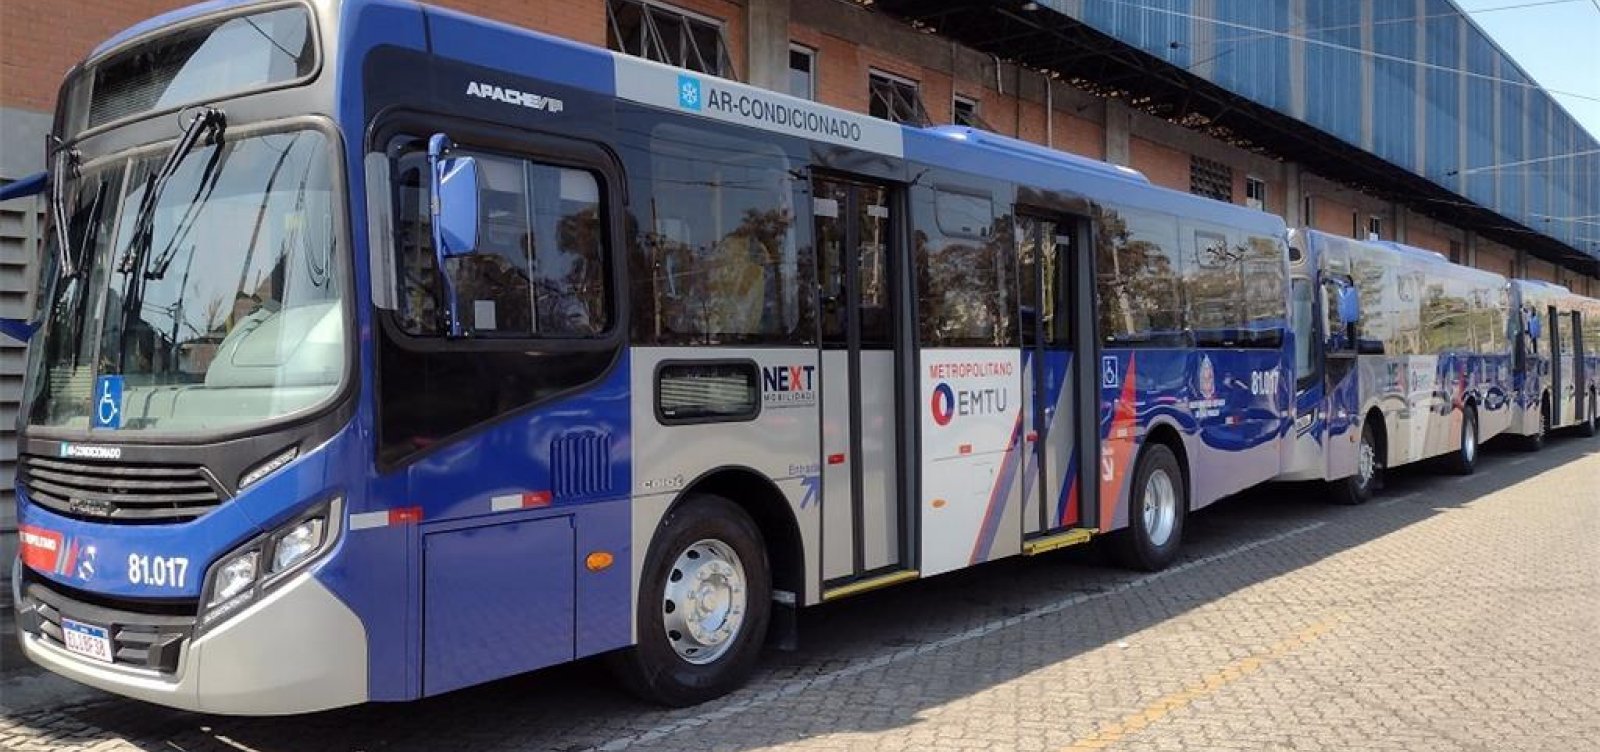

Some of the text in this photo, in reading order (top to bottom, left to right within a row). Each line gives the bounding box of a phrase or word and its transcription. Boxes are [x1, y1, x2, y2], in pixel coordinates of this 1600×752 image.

[707, 88, 862, 142] AR-CONDICIONADO
[763, 365, 815, 392] NEXT
[929, 361, 1013, 379] METROPOLITANO
[958, 387, 1007, 416] EMTU
[128, 553, 189, 588] 81.017
